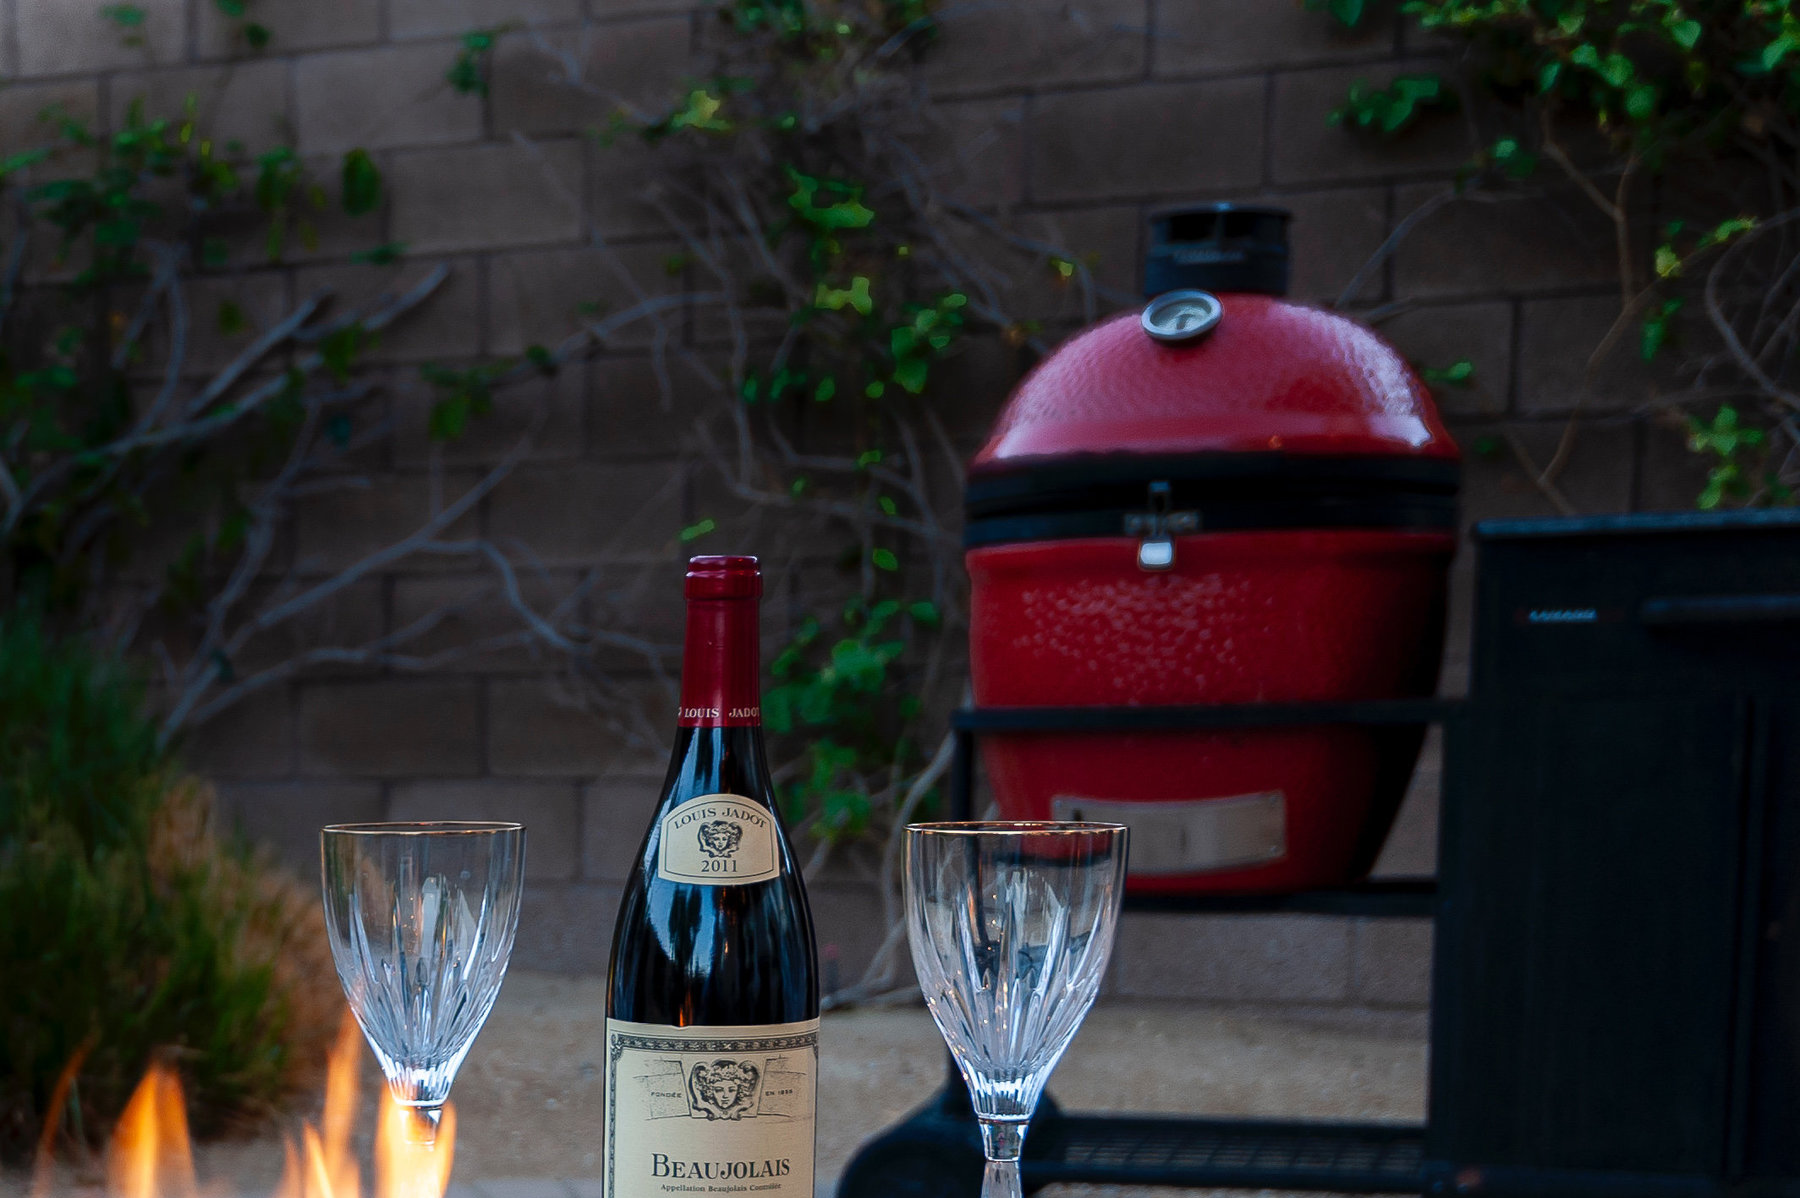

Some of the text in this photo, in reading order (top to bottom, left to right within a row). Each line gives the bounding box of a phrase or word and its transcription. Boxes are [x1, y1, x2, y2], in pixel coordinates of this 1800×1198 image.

[684, 707, 719, 718] LOUIS
[674, 807, 767, 829] LOUIS JADOT
[701, 860, 737, 872] 2011
[660, 1184, 705, 1193] Appellation
[708, 1184, 747, 1193] Beaujolais
